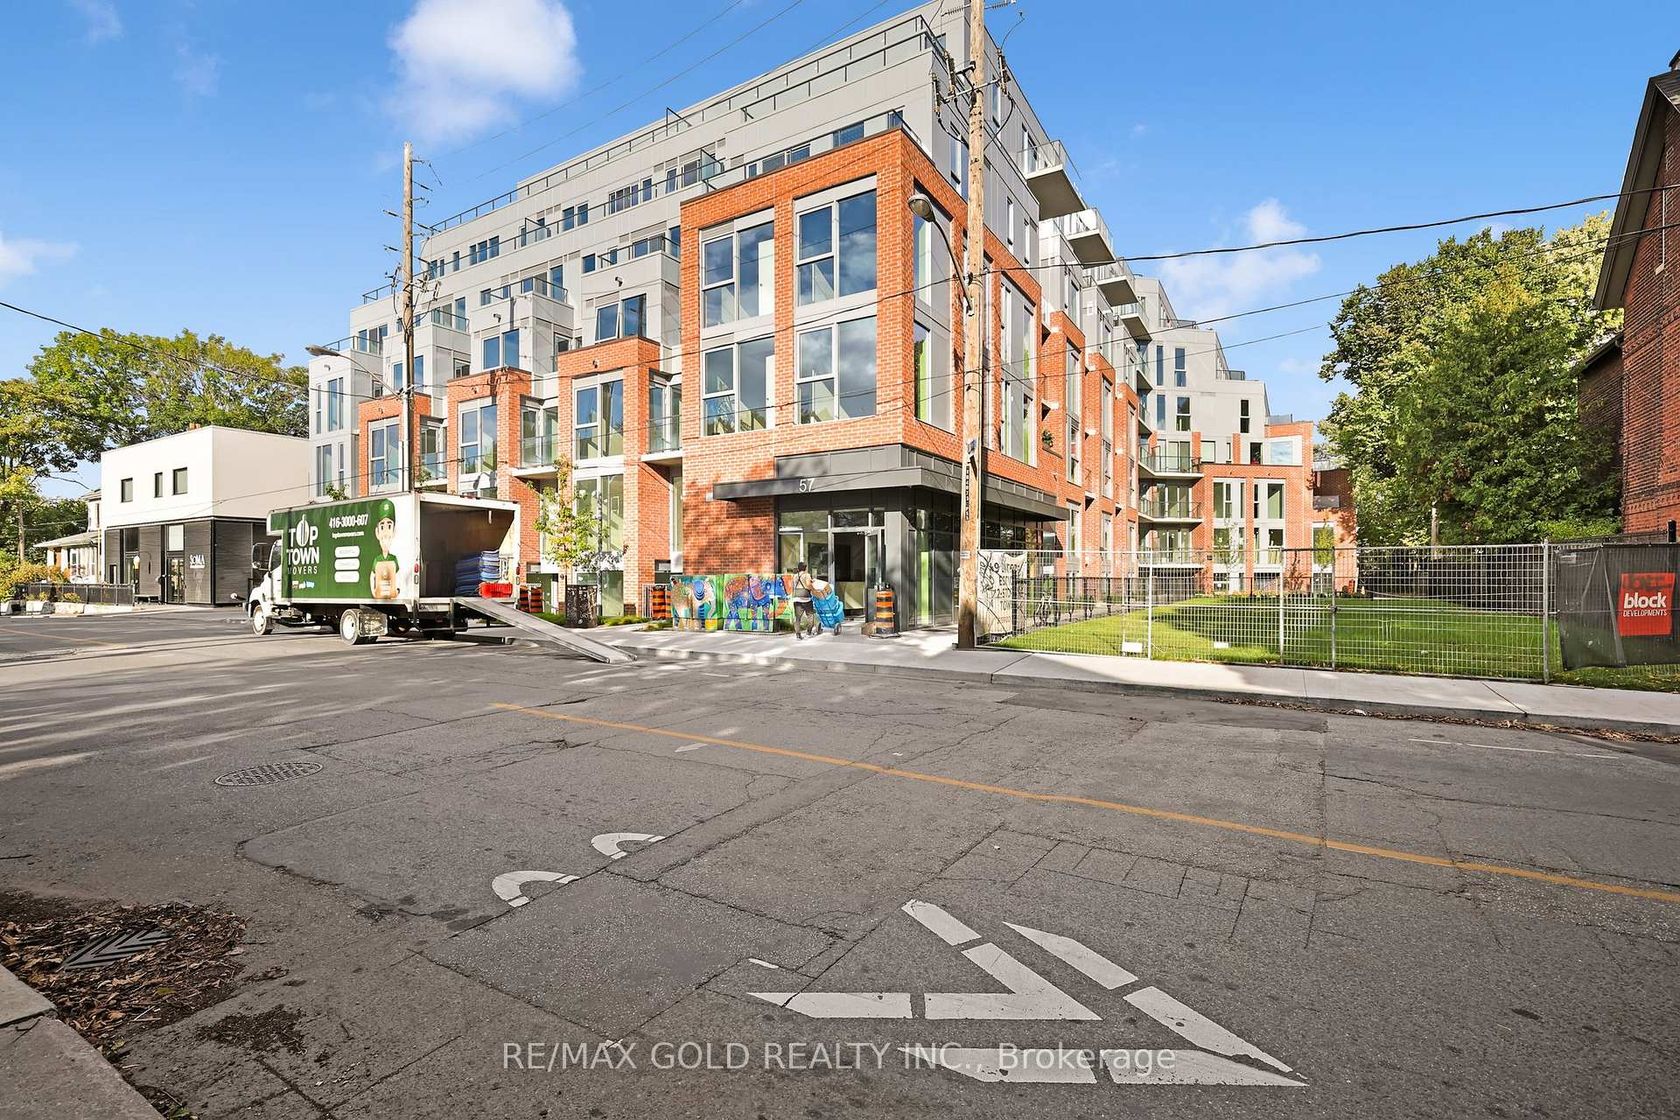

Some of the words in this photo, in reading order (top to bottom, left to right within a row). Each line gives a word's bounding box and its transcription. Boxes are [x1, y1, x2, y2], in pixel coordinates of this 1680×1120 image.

[799, 478, 815, 493] 57
[329, 514, 368, 528] 416-3000-607
[288, 514, 318, 547] TOP
[286, 547, 319, 565] TOWN
[1623, 592, 1667, 609] block
[1623, 609, 1667, 617] DEVELOPMENTS
